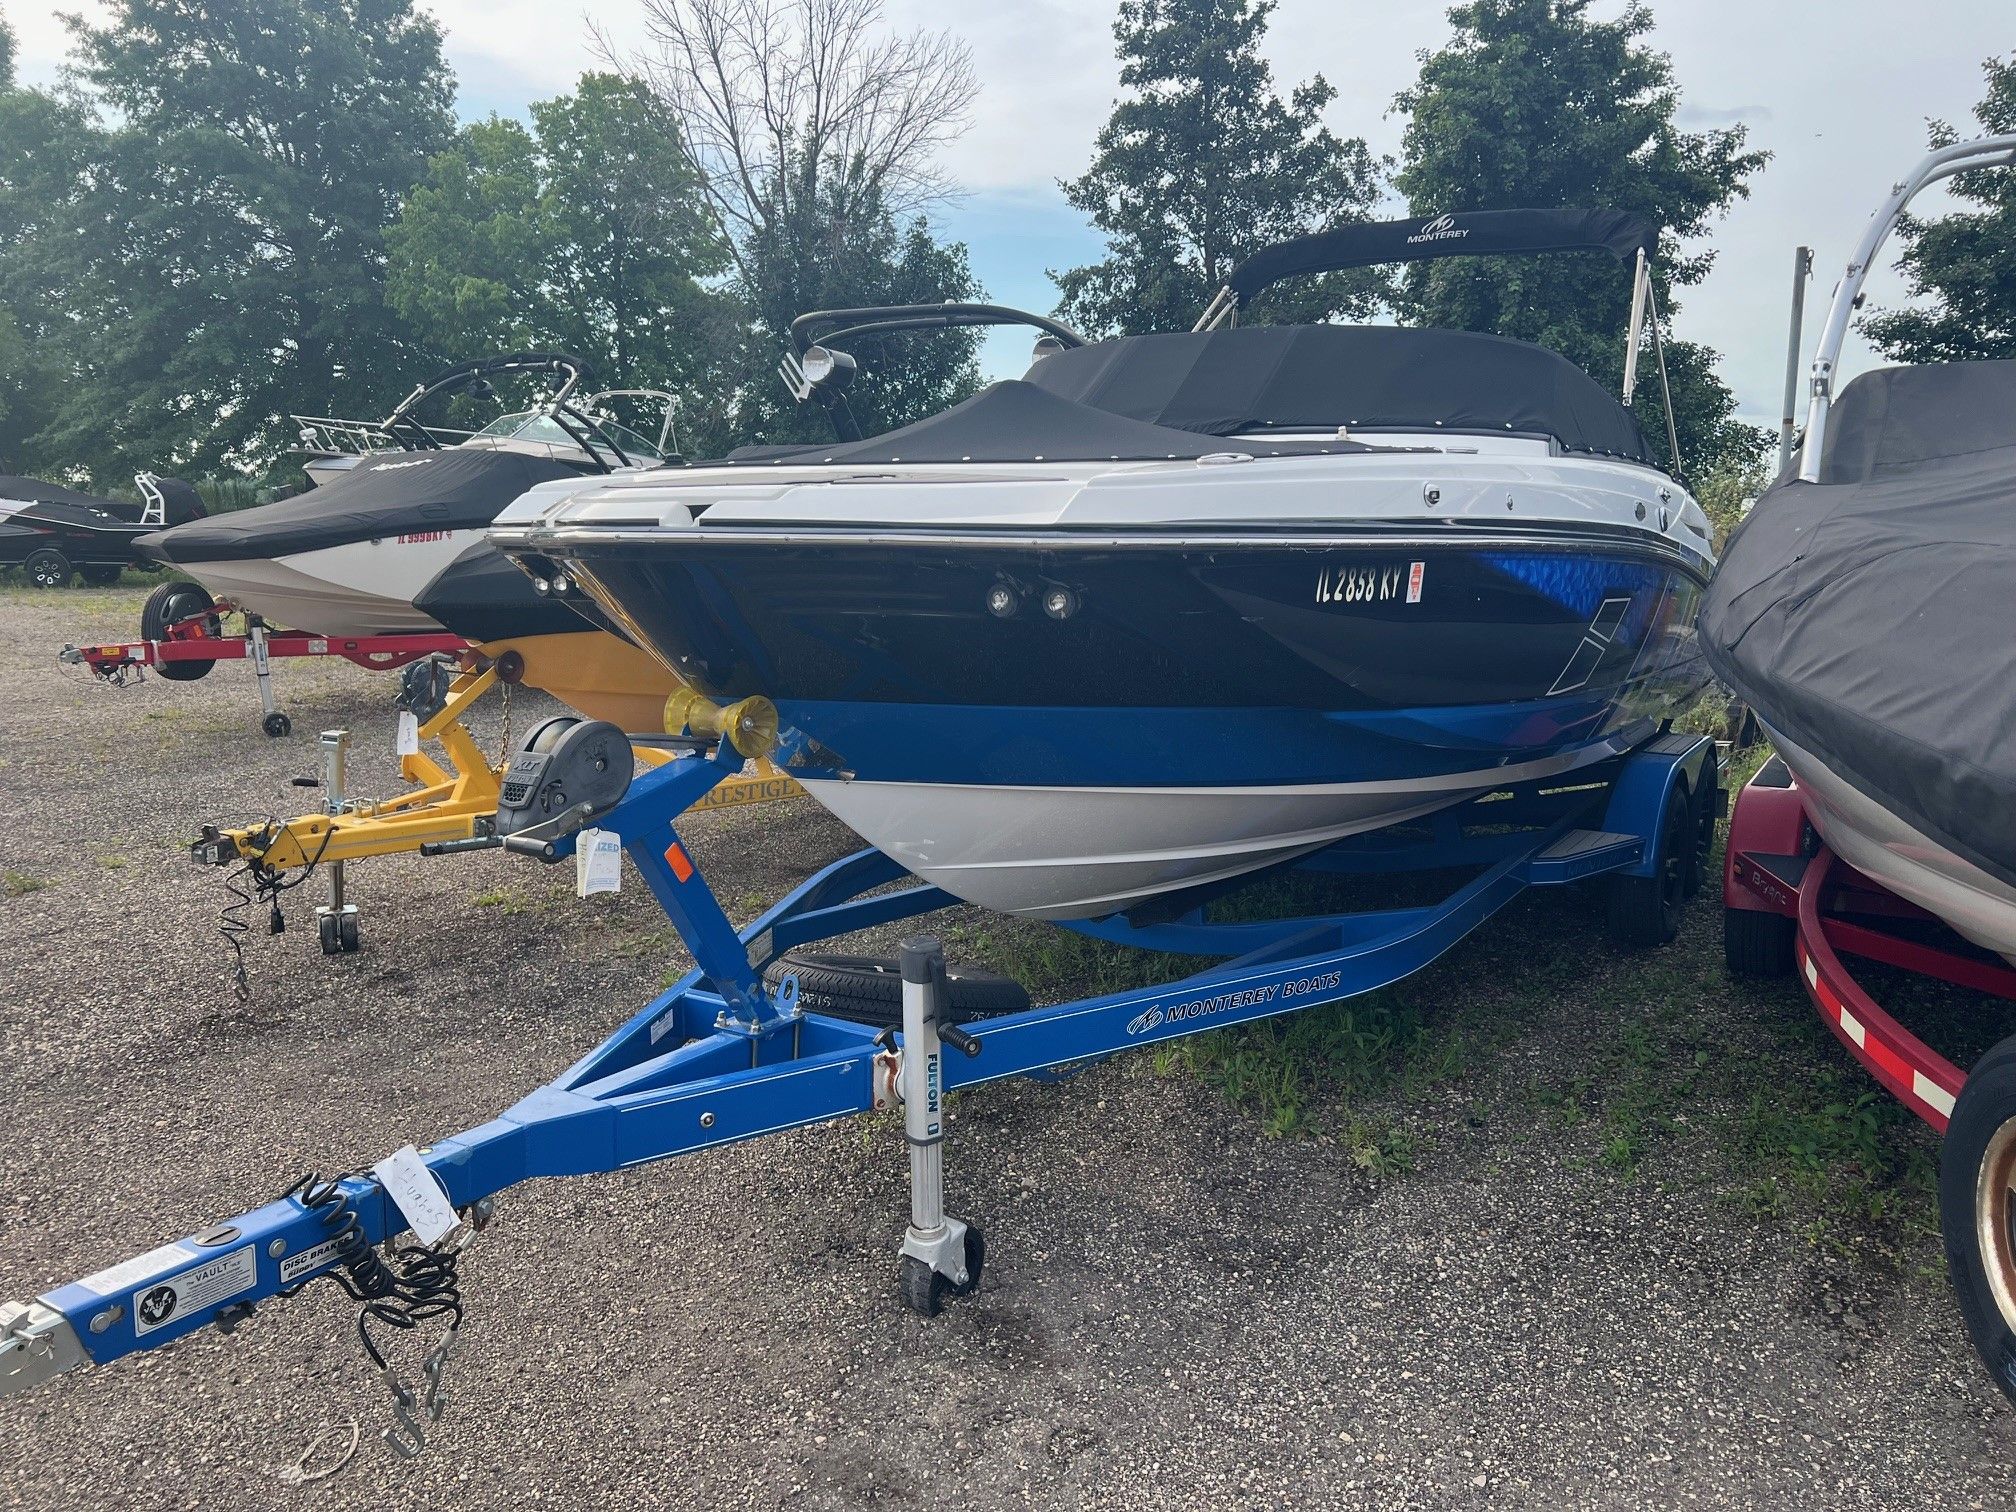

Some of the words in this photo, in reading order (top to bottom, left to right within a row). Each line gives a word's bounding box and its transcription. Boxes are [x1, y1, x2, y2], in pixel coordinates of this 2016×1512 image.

[1407, 229, 1469, 244] MONTEREY
[1316, 566, 1330, 602] IL
[1333, 566, 1376, 602] 2858
[1380, 565, 1402, 601] KY
[513, 759, 541, 772] XLT
[694, 779, 795, 807] RESTIGE
[1165, 984, 1281, 1023] MONTEREY
[1282, 971, 1342, 998] BOATS
[927, 1053, 938, 1112] FULTON
[195, 1262, 229, 1282] VAULT
[283, 1256, 308, 1271] DISC
[143, 1296, 173, 1314] VAULT
